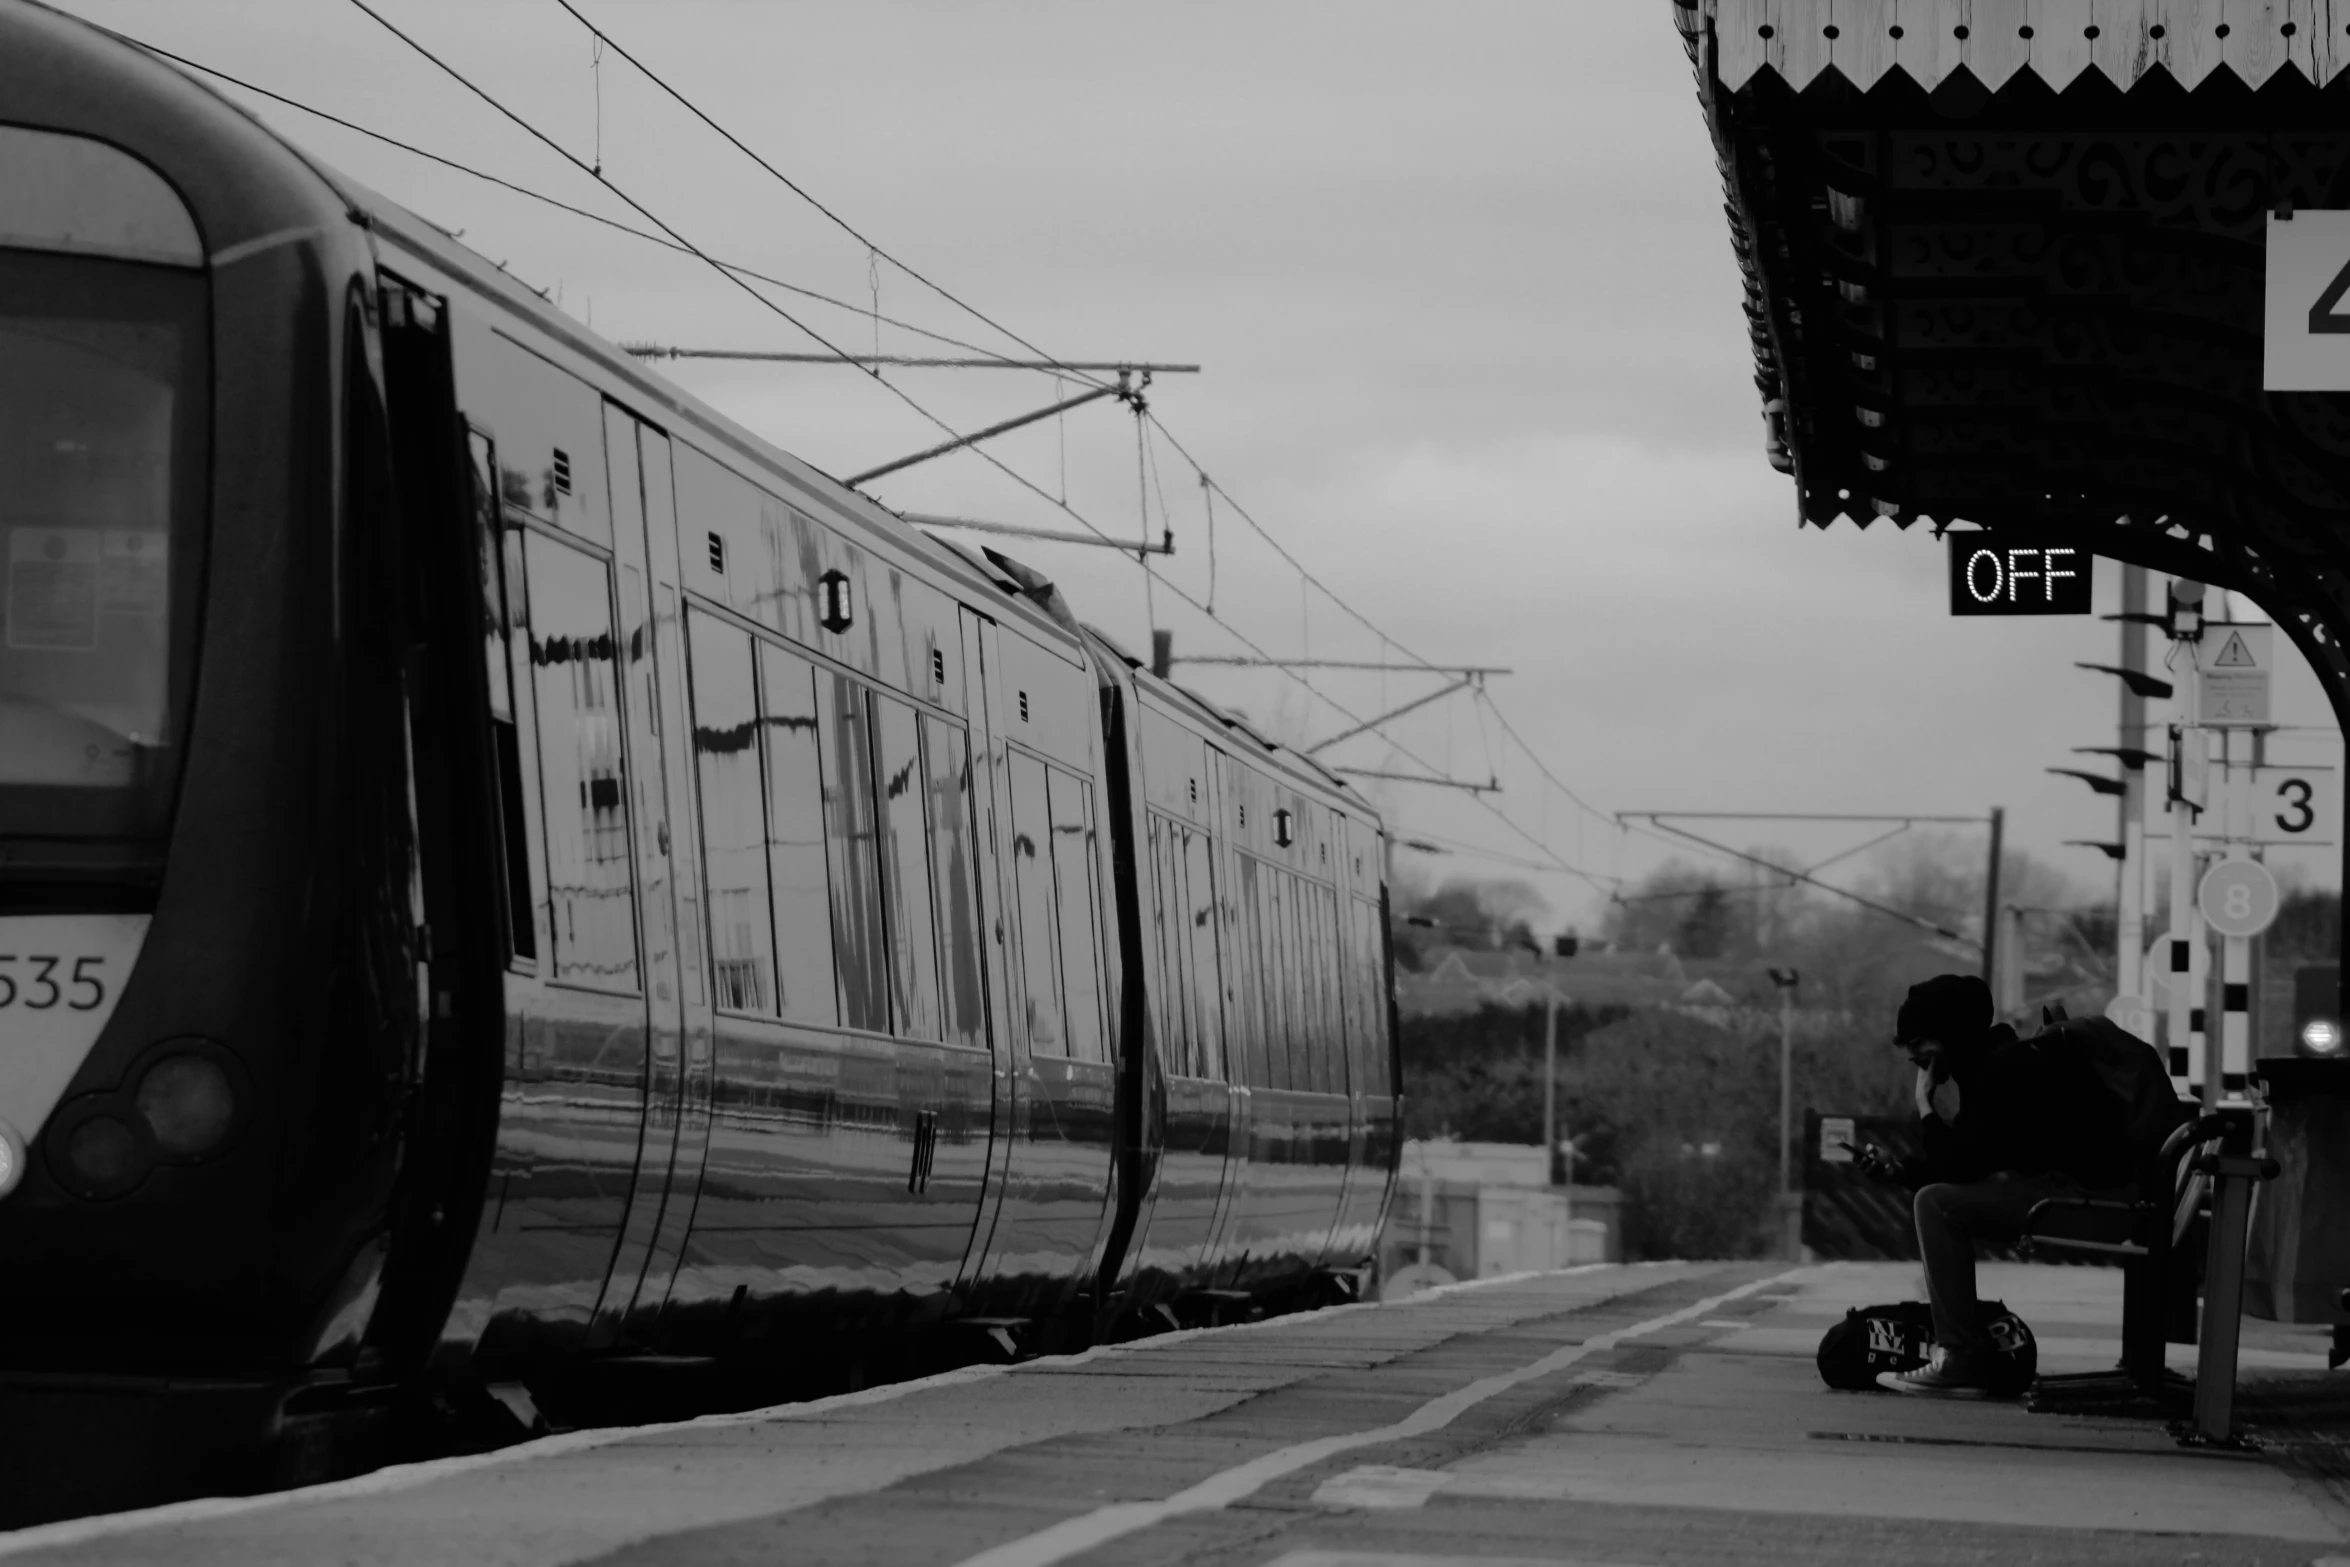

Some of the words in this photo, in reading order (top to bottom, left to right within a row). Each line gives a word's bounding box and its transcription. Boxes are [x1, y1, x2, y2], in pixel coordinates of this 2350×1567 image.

[1967, 548, 2076, 602] OFF
[2276, 778, 2314, 833] 3
[2223, 883, 2252, 920] 8
